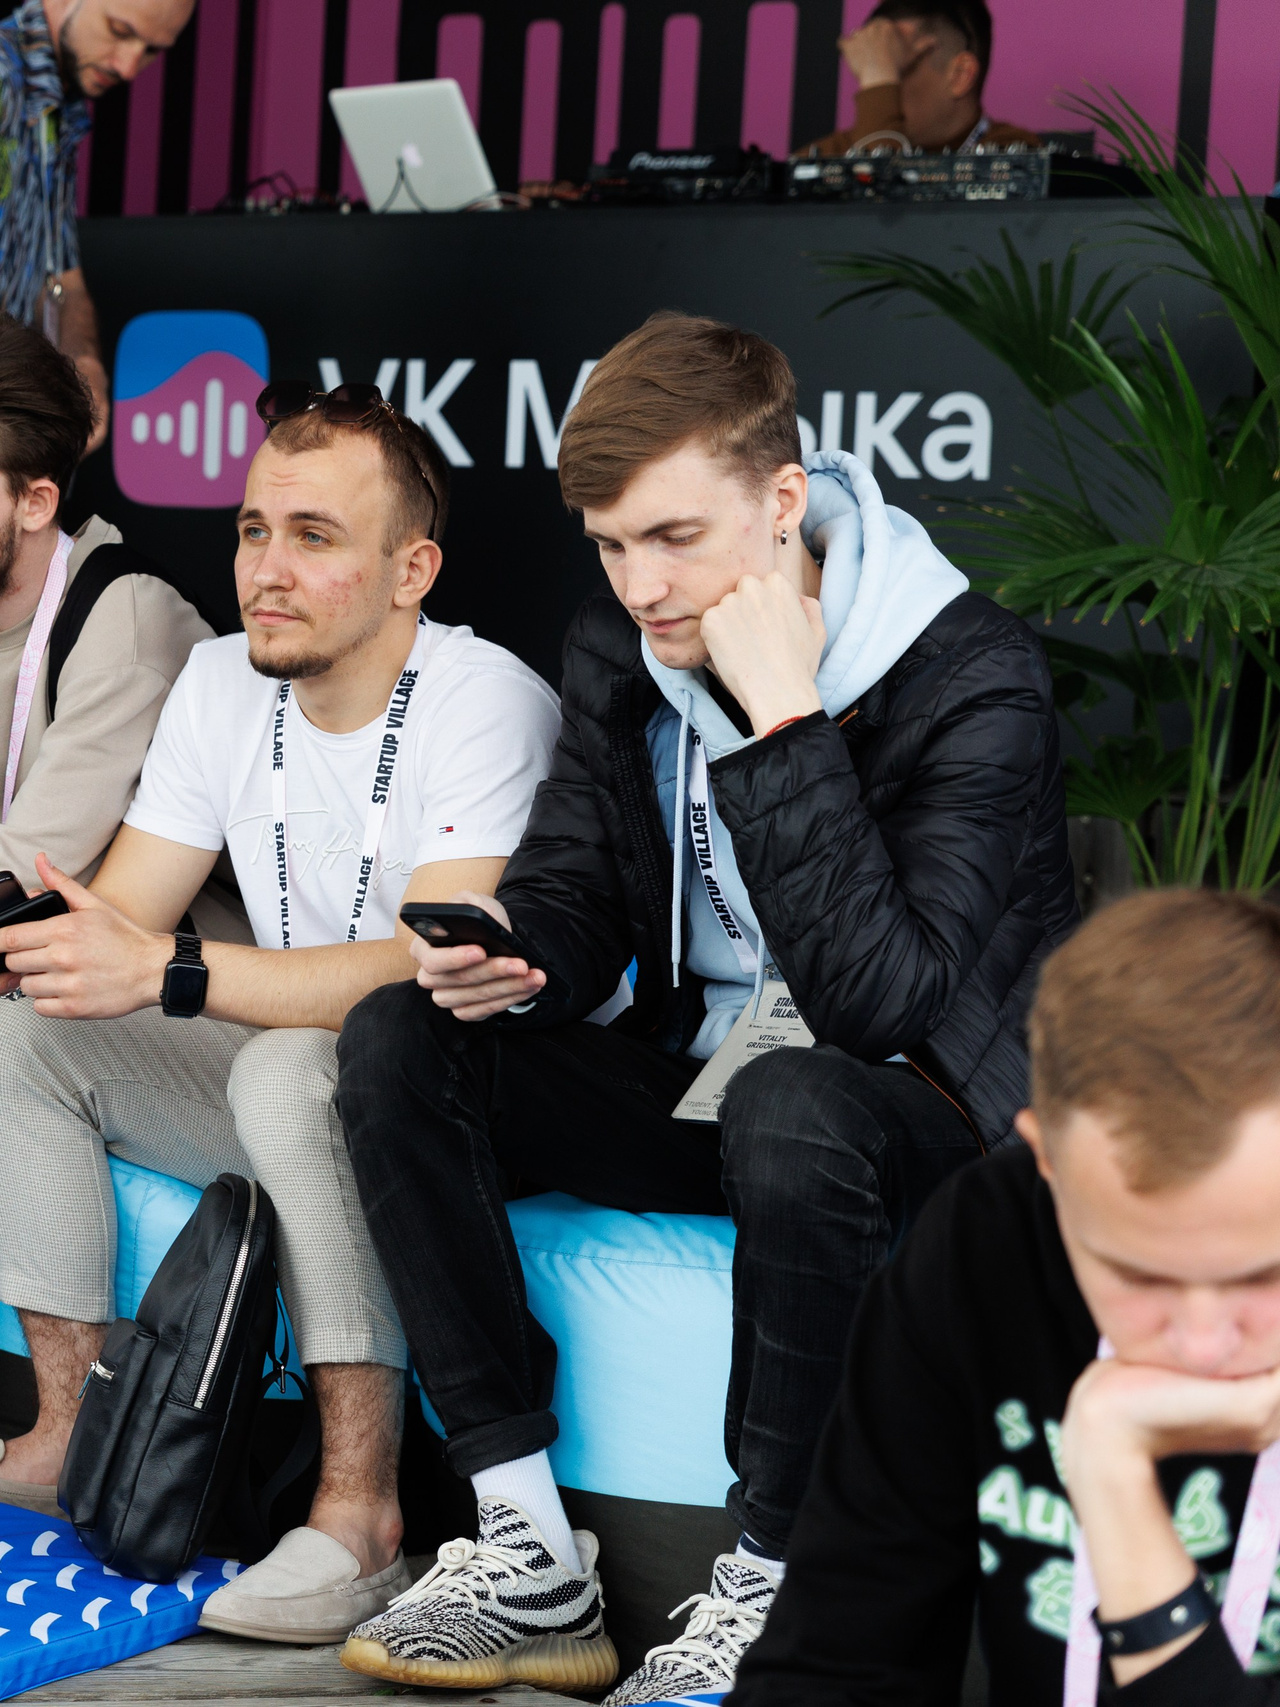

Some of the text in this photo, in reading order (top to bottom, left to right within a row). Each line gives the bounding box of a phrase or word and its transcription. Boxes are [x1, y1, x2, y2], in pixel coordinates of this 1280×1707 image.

[272, 706, 286, 771] VILLAGE
[371, 669, 420, 805] STARTUP VILLAGE
[274, 821, 291, 949] STARTUP VILLAG
[352, 854, 374, 919] VILLAGE
[691, 801, 743, 940] STARTUP VILLAGE
[774, 996, 797, 1008] STAR
[758, 1034, 788, 1043] VITALIY
